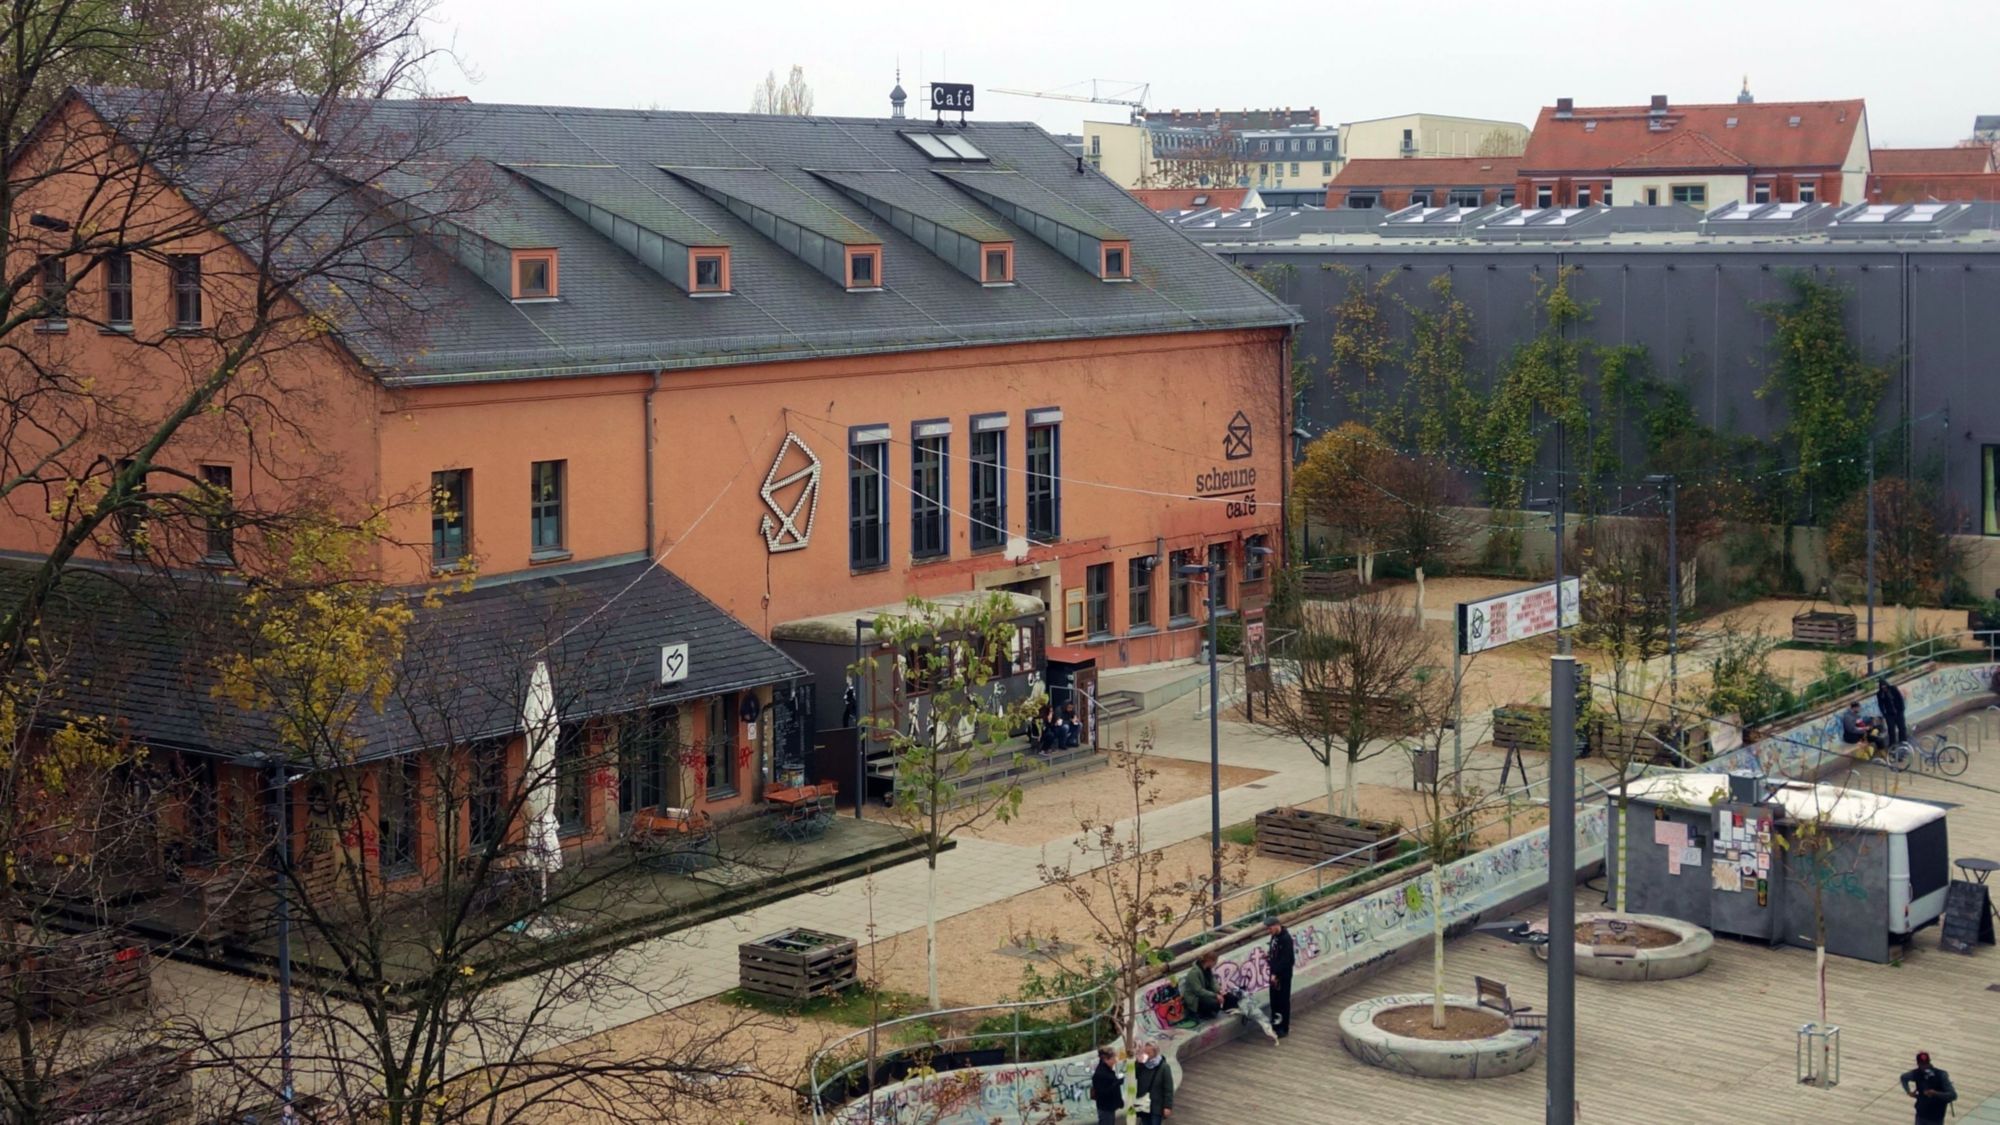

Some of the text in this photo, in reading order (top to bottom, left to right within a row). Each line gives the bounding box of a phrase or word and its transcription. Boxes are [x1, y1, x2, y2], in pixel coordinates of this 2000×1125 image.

[933, 86, 971, 107] Café
[1196, 466, 1256, 493] scheune
[1226, 493, 1256, 519] café
